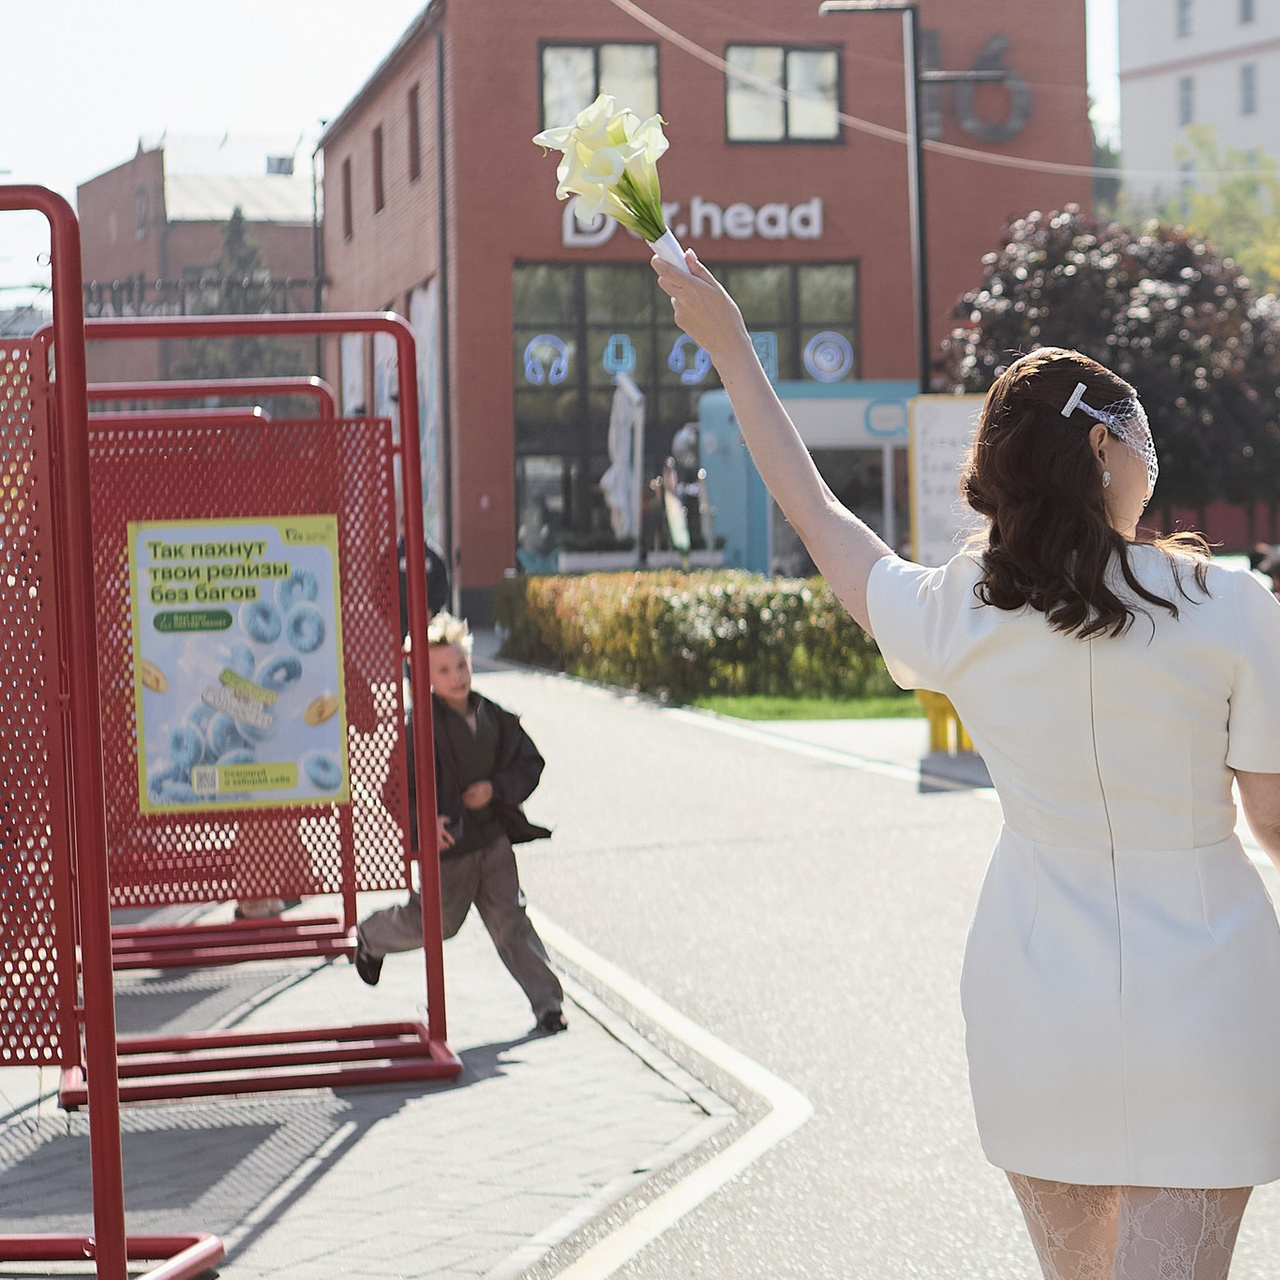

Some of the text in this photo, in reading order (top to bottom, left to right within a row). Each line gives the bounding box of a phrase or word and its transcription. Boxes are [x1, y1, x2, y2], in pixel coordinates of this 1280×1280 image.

[150, 540, 266, 560] Так пахнут
[150, 562, 289, 582] твои релизы
[151, 583, 257, 603] без багов
